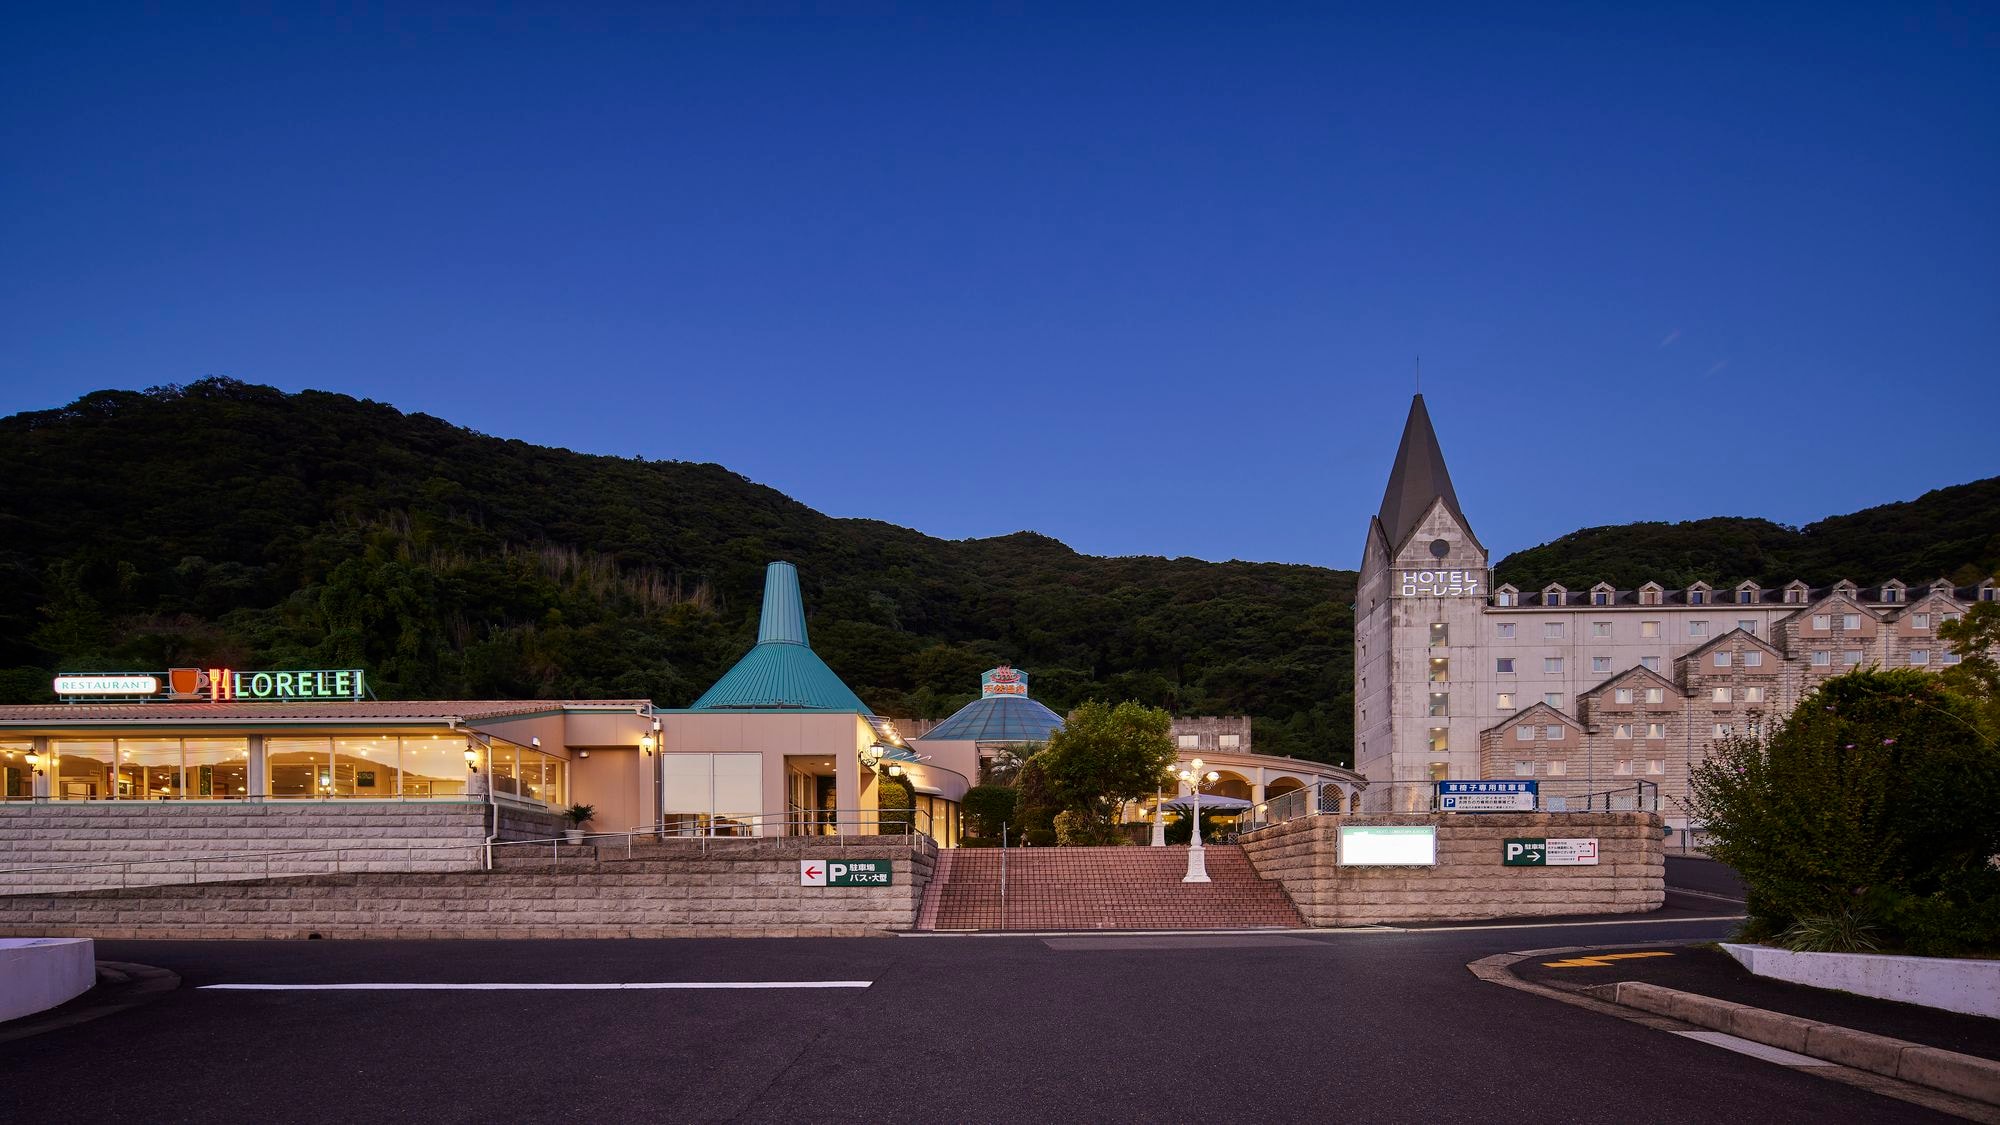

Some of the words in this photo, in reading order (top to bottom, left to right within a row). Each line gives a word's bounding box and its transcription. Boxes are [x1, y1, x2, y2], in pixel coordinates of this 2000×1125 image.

[1403, 571, 1478, 583] HOTEL
[1402, 583, 1479, 596] ローレライ
[61, 681, 150, 690] RESTAURANT
[235, 671, 364, 697] LORELEI
[1446, 798, 1454, 807] P
[1507, 843, 1524, 861] P
[829, 863, 848, 882] P
[849, 863, 876, 872] 駐車場
[849, 873, 888, 882] バス・大型
